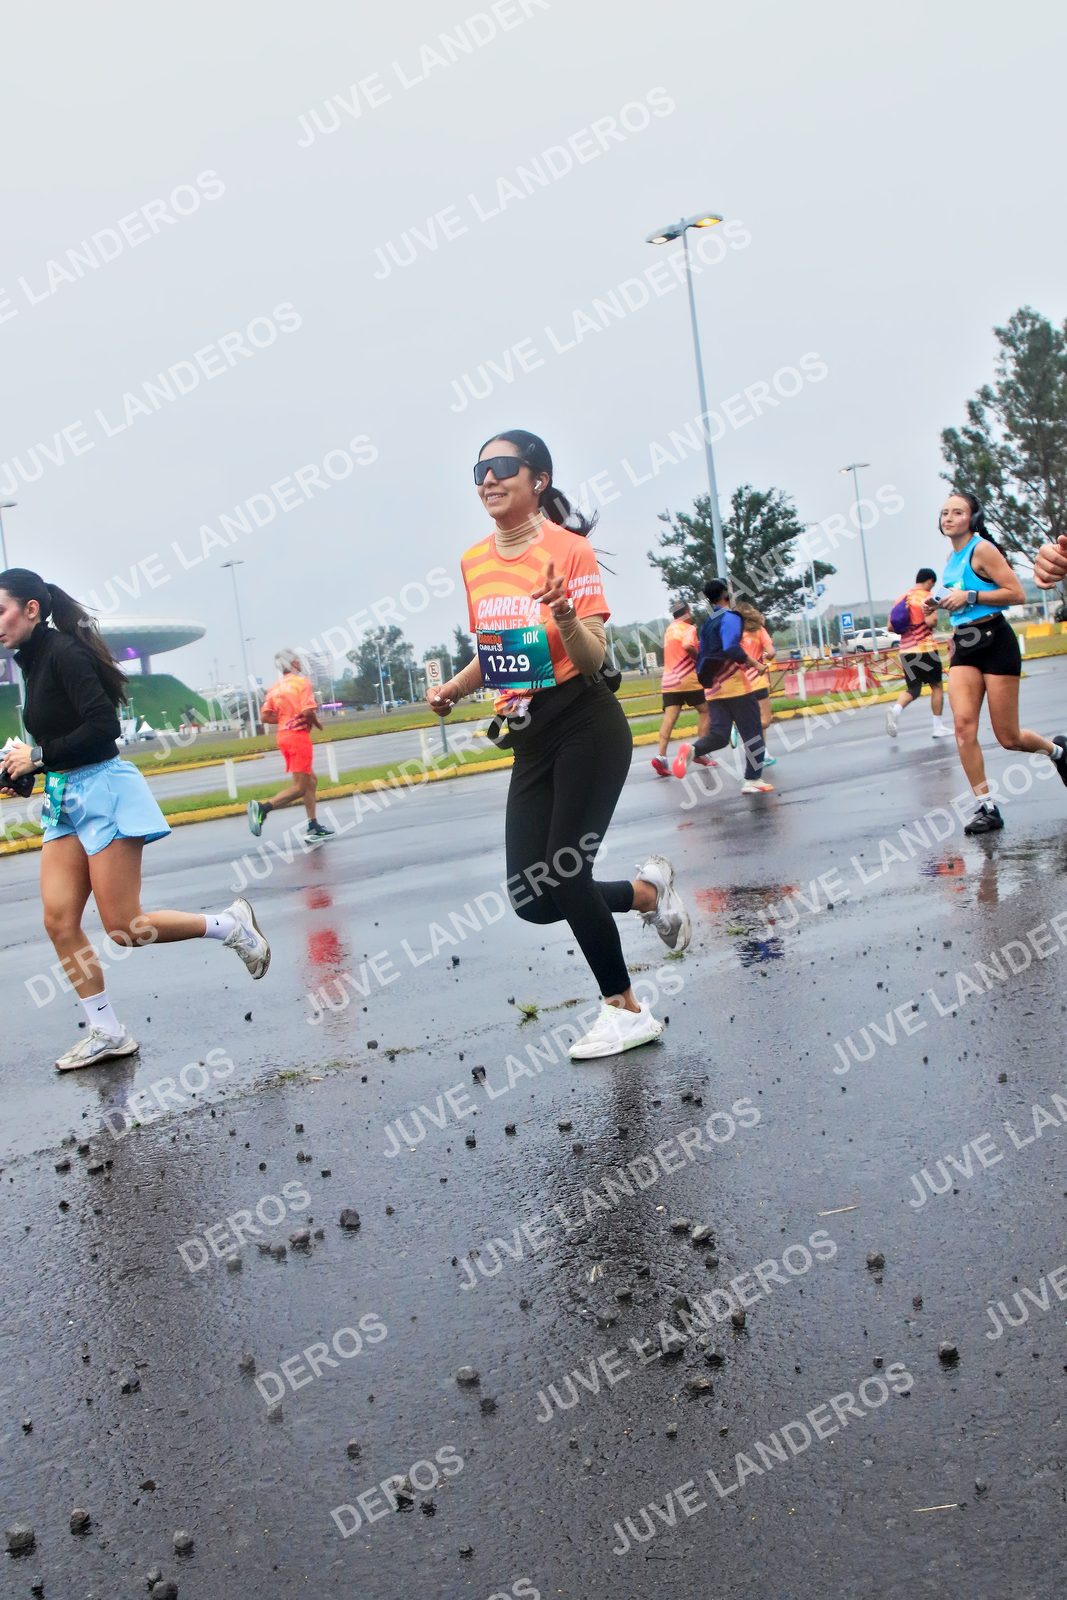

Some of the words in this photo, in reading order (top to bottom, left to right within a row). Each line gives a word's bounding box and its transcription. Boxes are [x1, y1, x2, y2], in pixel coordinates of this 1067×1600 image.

[478, 596, 540, 619] CARRERA
[479, 618, 523, 631] OMNILIFE
[522, 630, 539, 645] 10K
[487, 654, 530, 672] 1229
